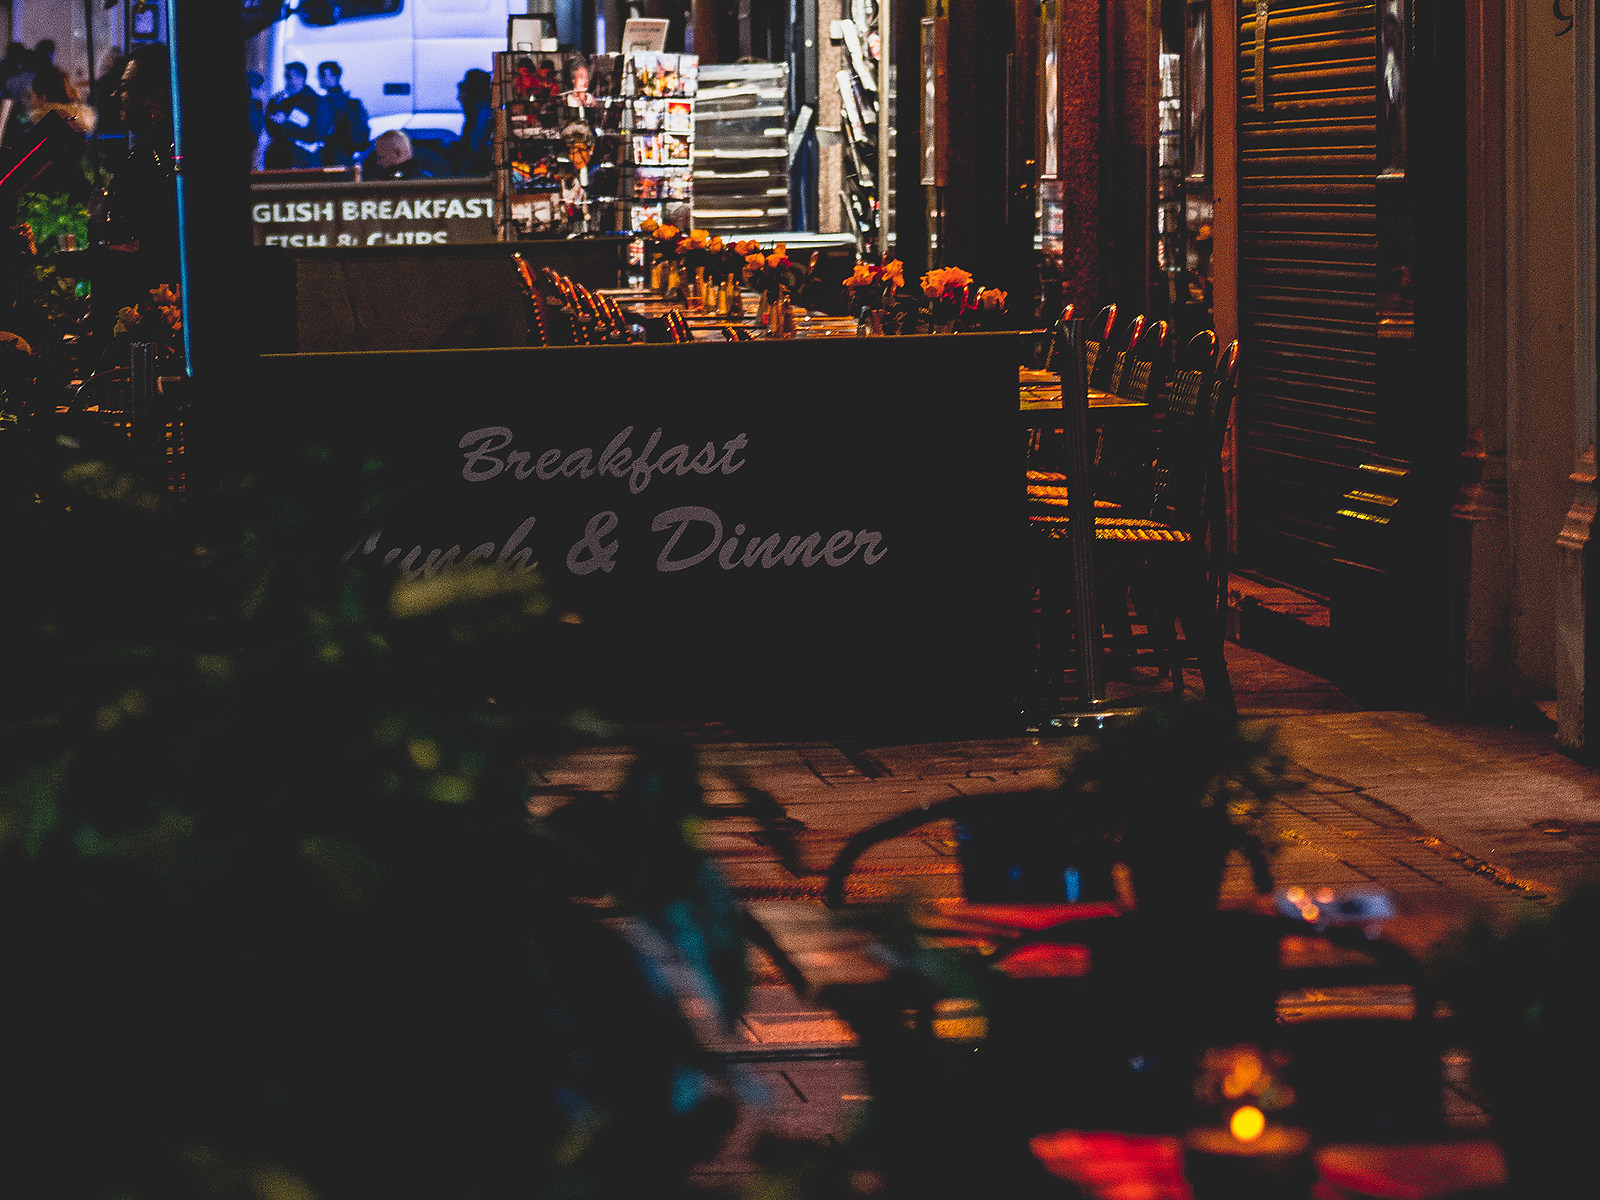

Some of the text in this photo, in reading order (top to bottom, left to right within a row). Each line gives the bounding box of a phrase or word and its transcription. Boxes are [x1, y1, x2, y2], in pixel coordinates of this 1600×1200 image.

[252, 198, 494, 223] GLISH BREAKFAST
[458, 425, 750, 495] Breakfast
[565, 510, 620, 576] &
[651, 505, 888, 573] Dinner
